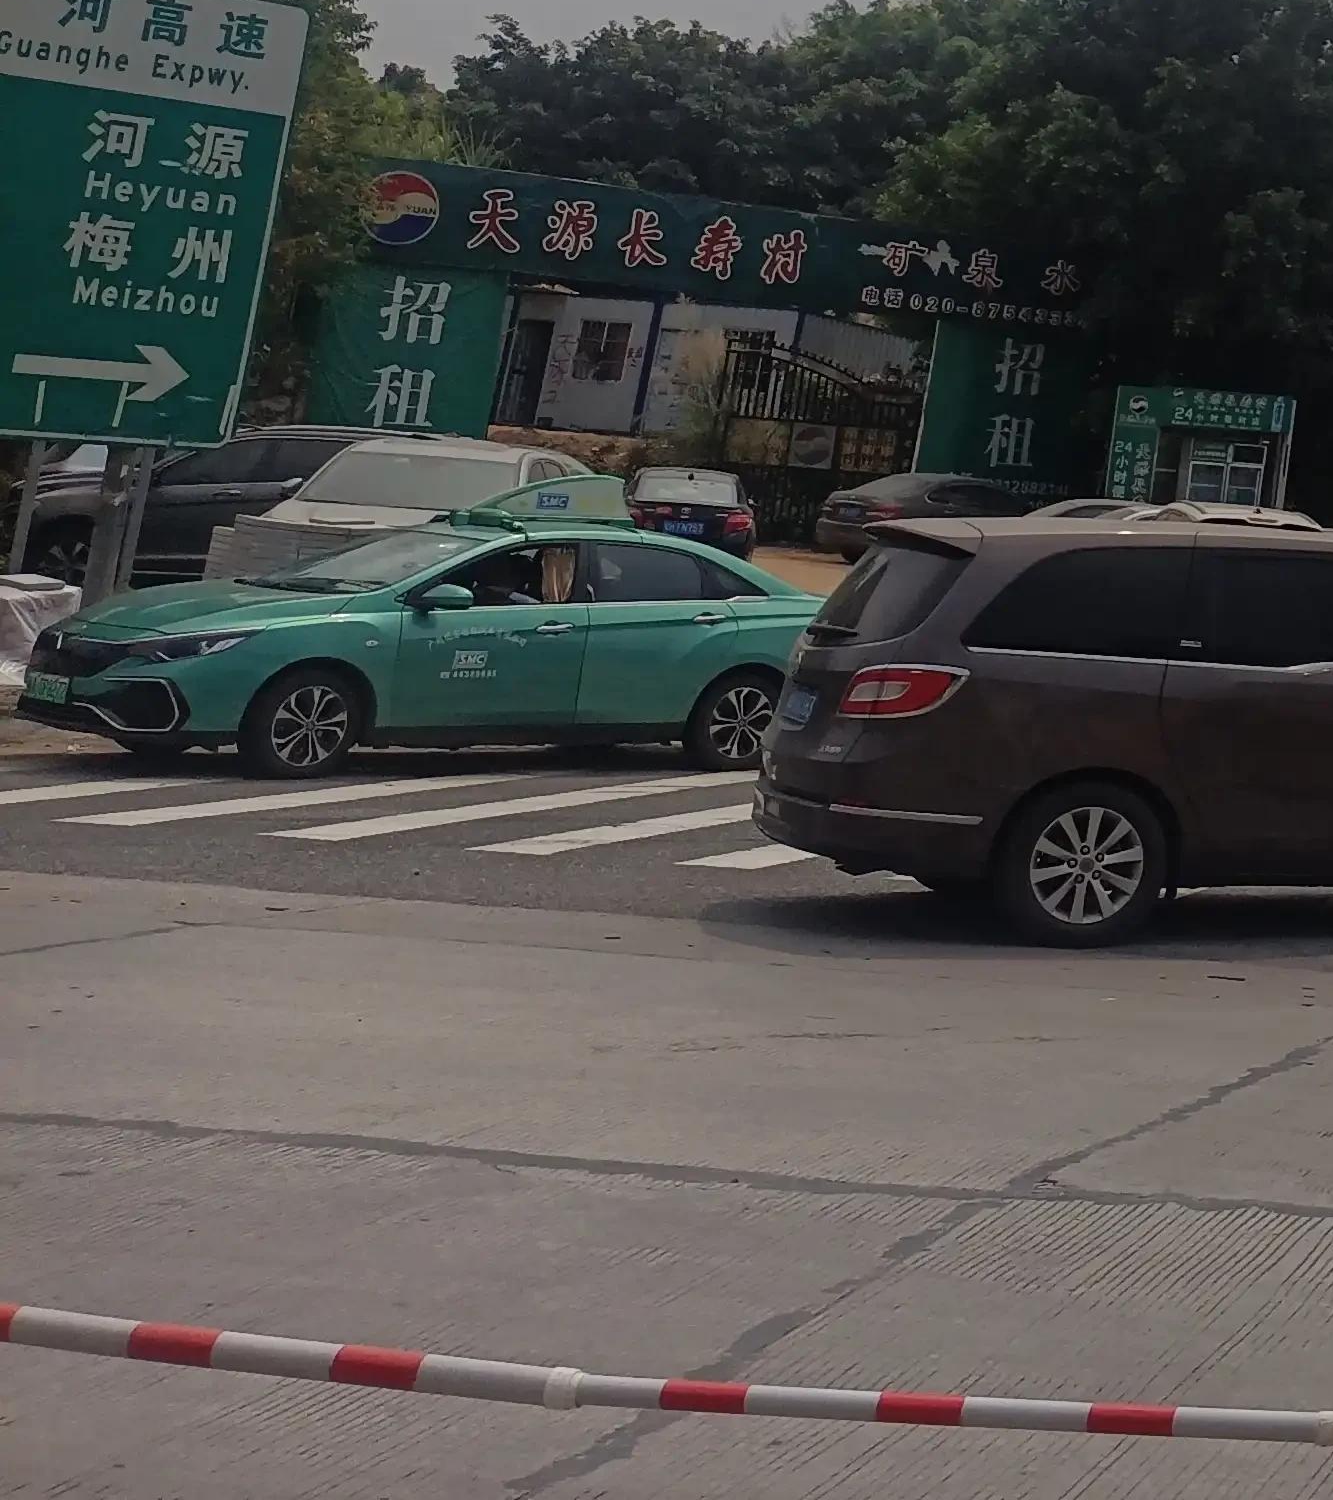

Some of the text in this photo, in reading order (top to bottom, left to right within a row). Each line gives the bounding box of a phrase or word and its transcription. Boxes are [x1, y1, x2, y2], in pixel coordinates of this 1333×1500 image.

[0, 30, 249, 94] Guanghe Expwy.
[82, 109, 249, 180] 河源
[84, 171, 236, 216] Heyuan
[63, 211, 233, 284] 梅州
[72, 276, 219, 318] Meizhou
